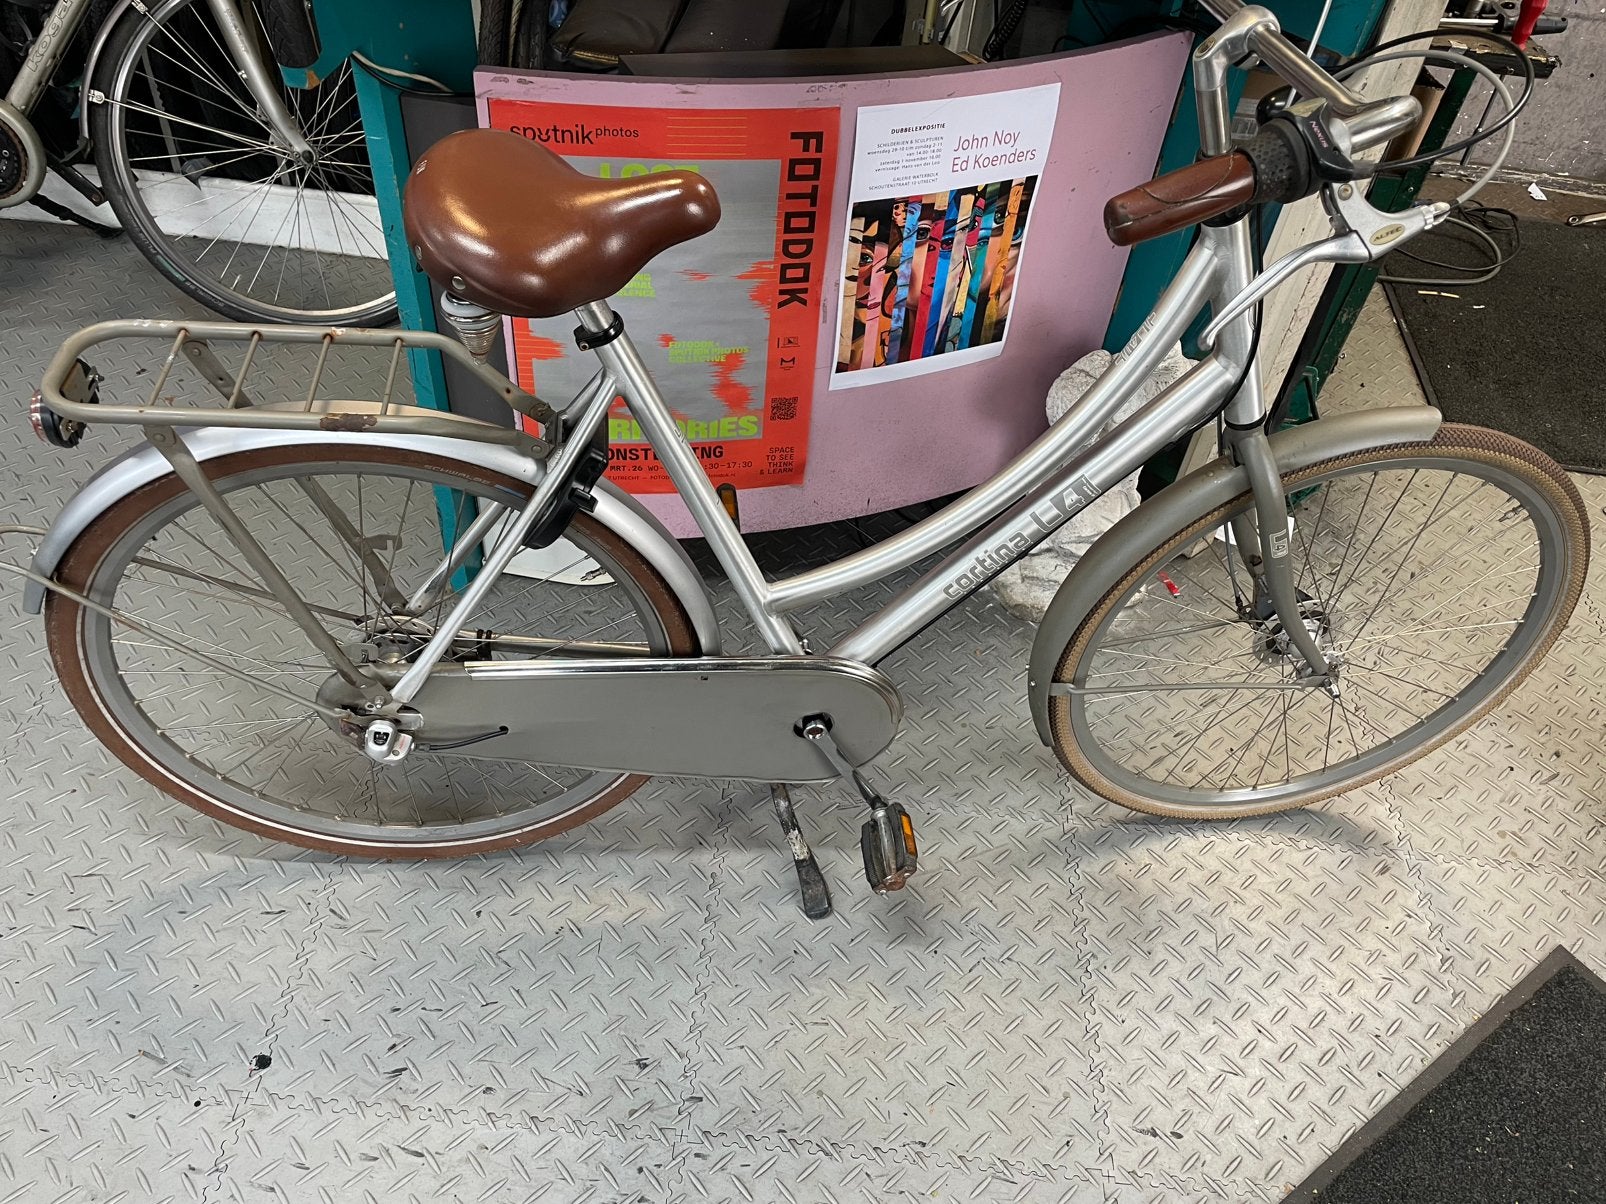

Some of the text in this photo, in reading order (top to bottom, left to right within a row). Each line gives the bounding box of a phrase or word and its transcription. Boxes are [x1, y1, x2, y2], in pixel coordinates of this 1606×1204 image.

[595, 125, 640, 139] photos
[891, 123, 946, 134] DUBBELEXPOSITIE
[953, 130, 1021, 152] John Noy
[952, 148, 1037, 173] Ed Koenders
[777, 131, 824, 309] FOTODOK
[1373, 228, 1402, 242] ALTEC
[942, 530, 1031, 600] cortina
